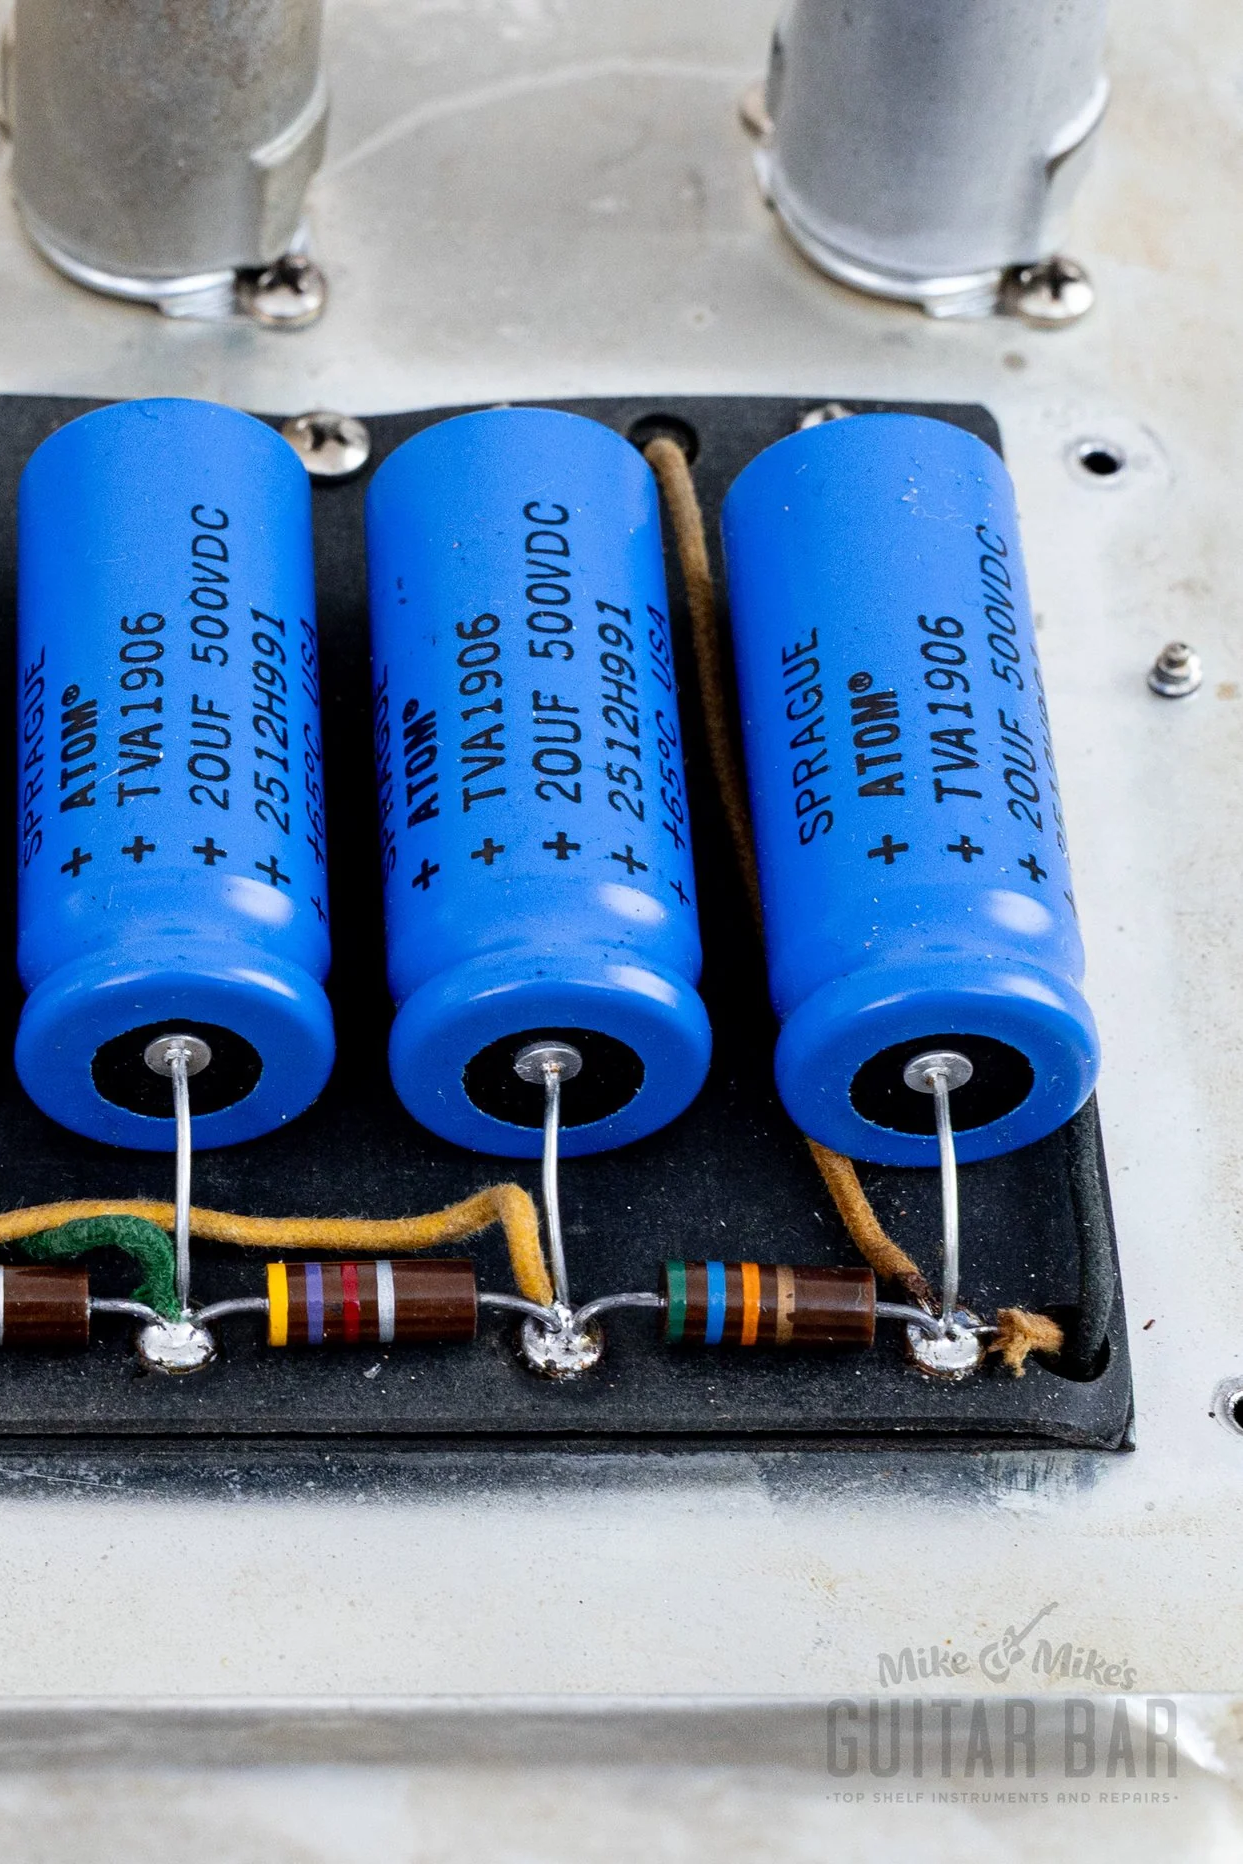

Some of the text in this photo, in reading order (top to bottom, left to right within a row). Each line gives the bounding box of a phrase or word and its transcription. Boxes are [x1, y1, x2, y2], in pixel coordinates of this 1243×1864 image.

[189, 504, 230, 667] 500VDC
[523, 500, 575, 662] 500VDC
[647, 604, 673, 693] USA
[976, 524, 1025, 691] 500VDC
[24, 644, 46, 868] SPRAGUE
[116, 611, 166, 808] TVA1906
[187, 694, 232, 810] 20UF
[250, 608, 290, 835] 2512H991
[456, 612, 507, 813] TVA1906
[532, 689, 583, 804] 20UF
[595, 599, 645, 822] 2512H991
[781, 627, 834, 846] SPRAGUE
[917, 614, 983, 804] TVA1906
[998, 708, 1044, 833] 20UF
